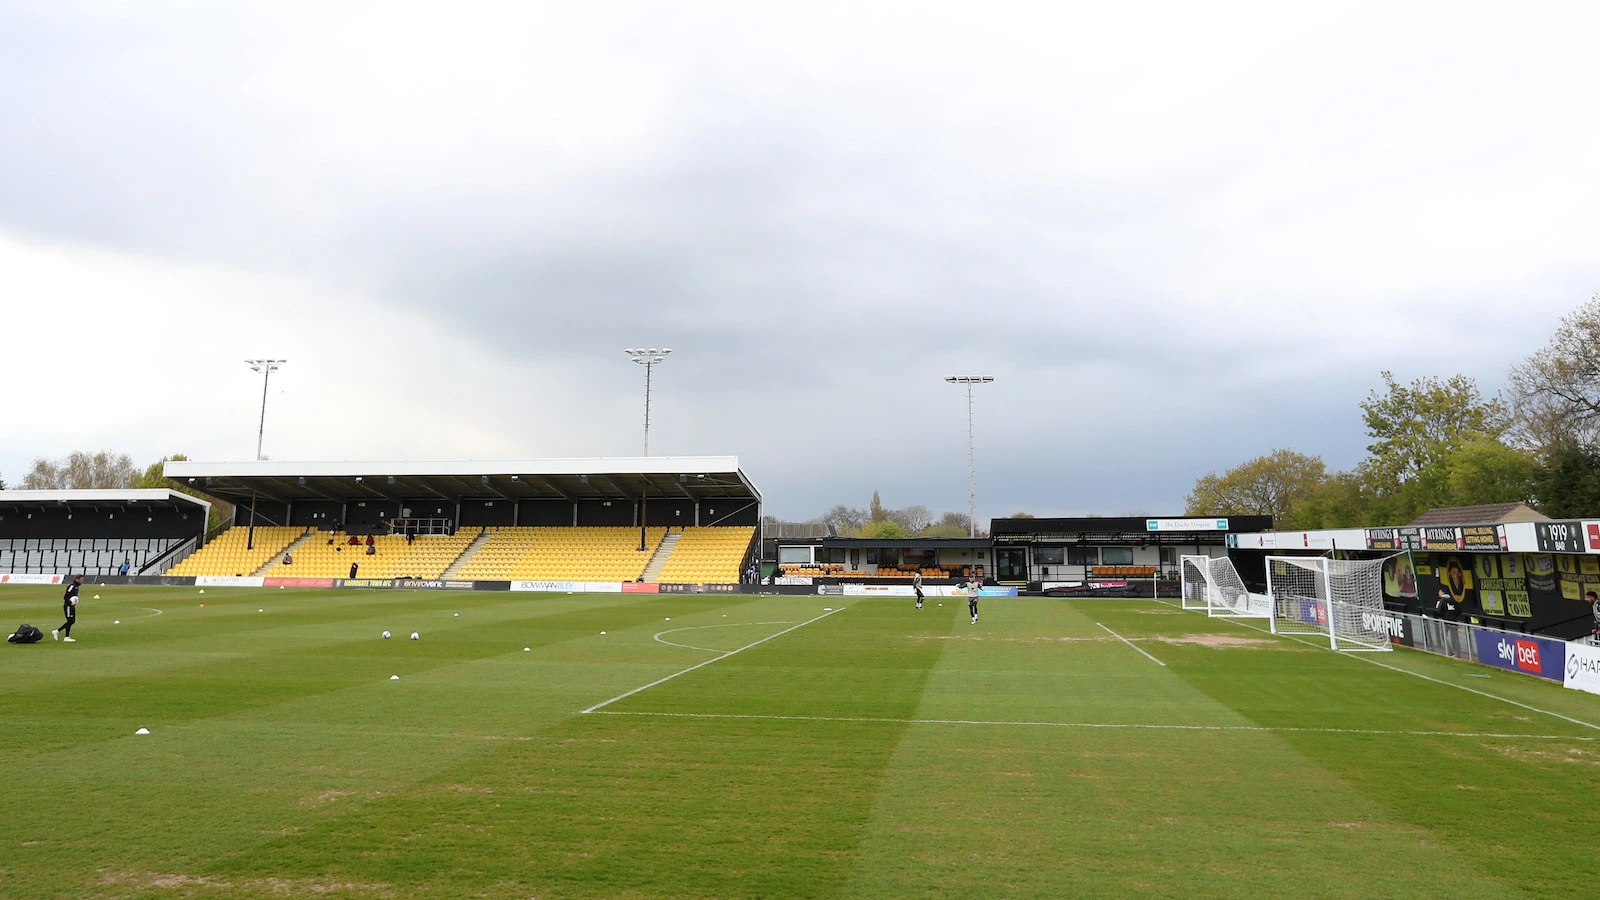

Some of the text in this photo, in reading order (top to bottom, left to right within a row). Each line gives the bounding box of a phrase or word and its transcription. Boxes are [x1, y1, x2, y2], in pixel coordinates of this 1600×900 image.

[1427, 528, 1454, 540] MYRINGS
[1548, 524, 1567, 541] 1919
[1555, 541, 1566, 550] BAR
[344, 579, 369, 587] HARROGATE
[404, 580, 442, 588] envirovent
[1362, 612, 1404, 638] SPORTFIVE
[1497, 638, 1538, 665] sky bet
